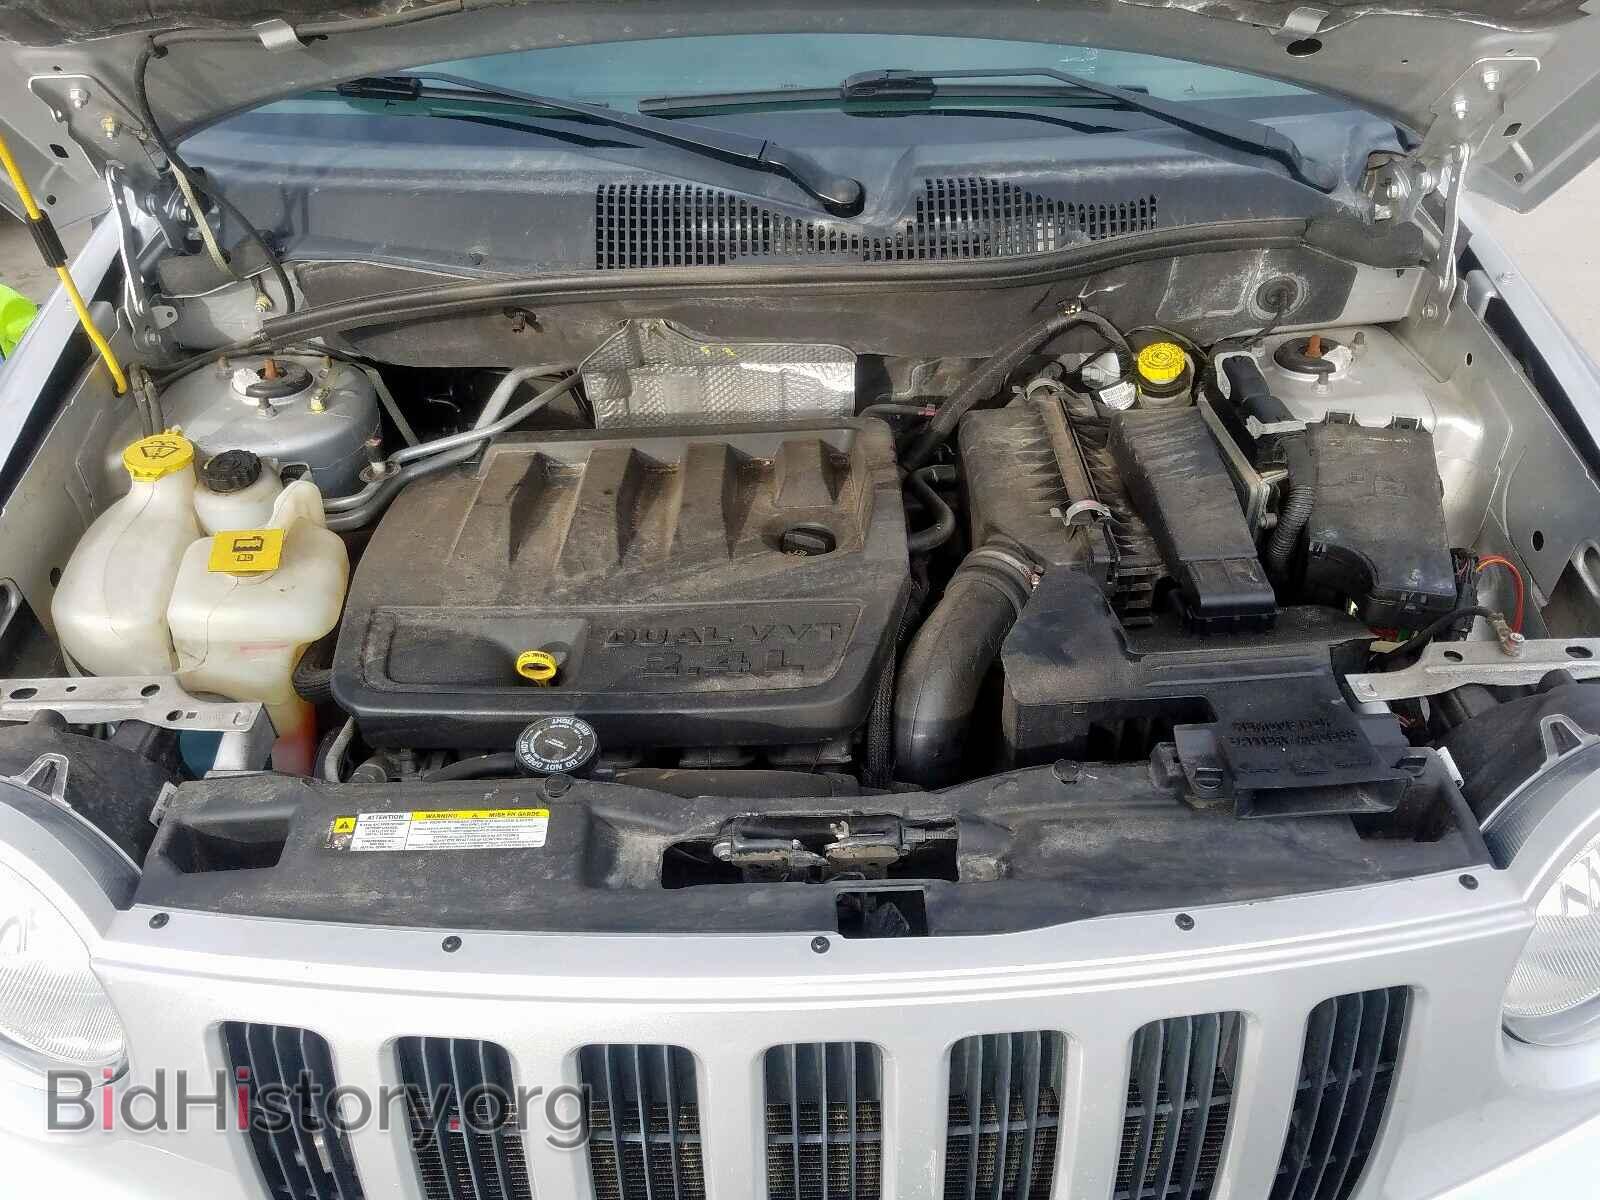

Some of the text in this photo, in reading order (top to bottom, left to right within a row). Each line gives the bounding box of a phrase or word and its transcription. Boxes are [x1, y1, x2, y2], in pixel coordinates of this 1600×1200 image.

[605, 621, 842, 647] DUAL VVT
[575, 722, 591, 736] KEEP
[520, 740, 529, 753] HOT
[523, 754, 543, 768] OPEN
[544, 763, 563, 771] NOT
[565, 758, 579, 768] DO
